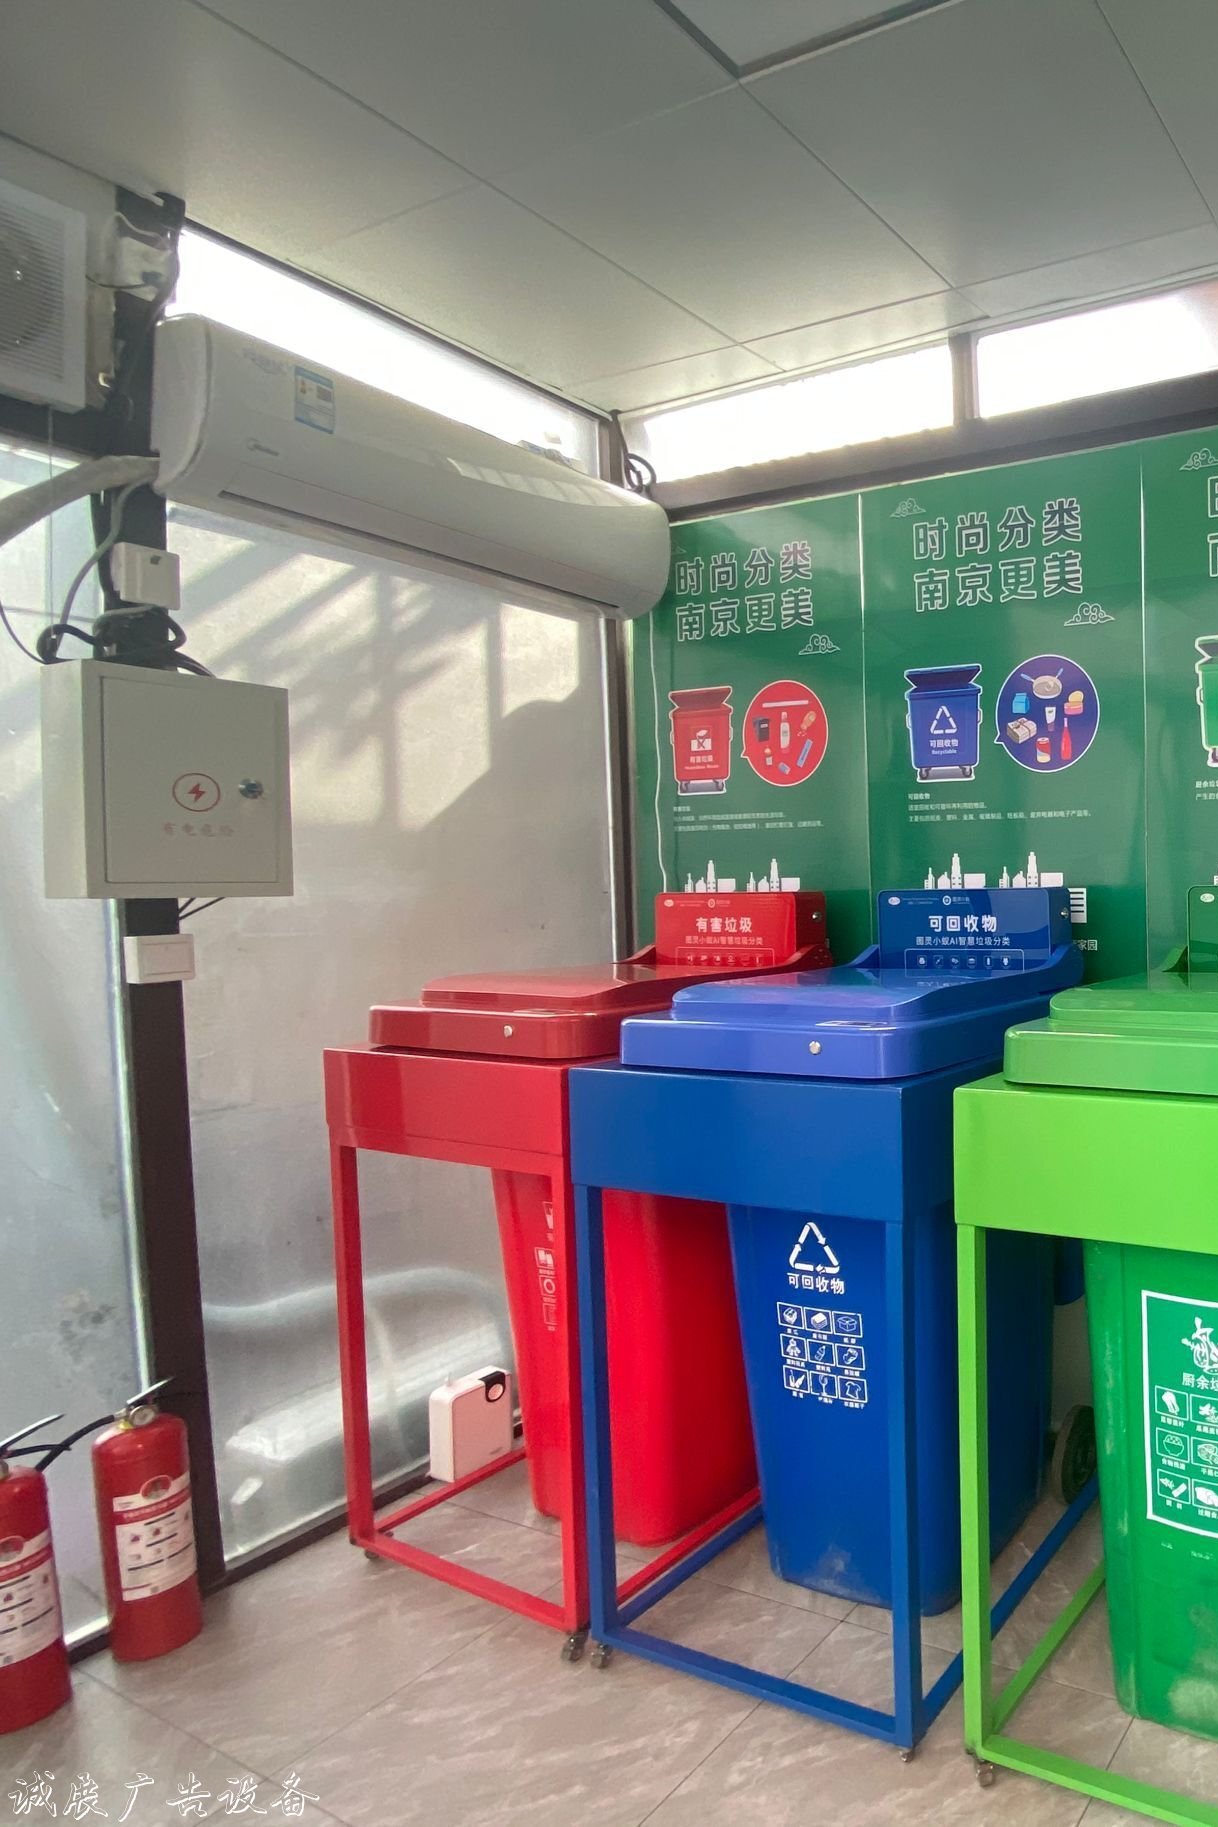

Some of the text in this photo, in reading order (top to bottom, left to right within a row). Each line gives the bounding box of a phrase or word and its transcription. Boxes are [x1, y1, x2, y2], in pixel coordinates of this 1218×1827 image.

[913, 497, 1083, 561] 时尚分类
[675, 540, 813, 597] 时尚分类
[913, 550, 1084, 613] 南京更美
[675, 587, 815, 642] 南京更美
[929, 739, 959, 749] 可回收物
[695, 917, 753, 933] 有害垃圾
[928, 914, 998, 933] 可回收物
[916, 936, 1011, 947] 图灵小蚁AI智慧垃圾分类
[787, 1272, 844, 1294] 可回收物
